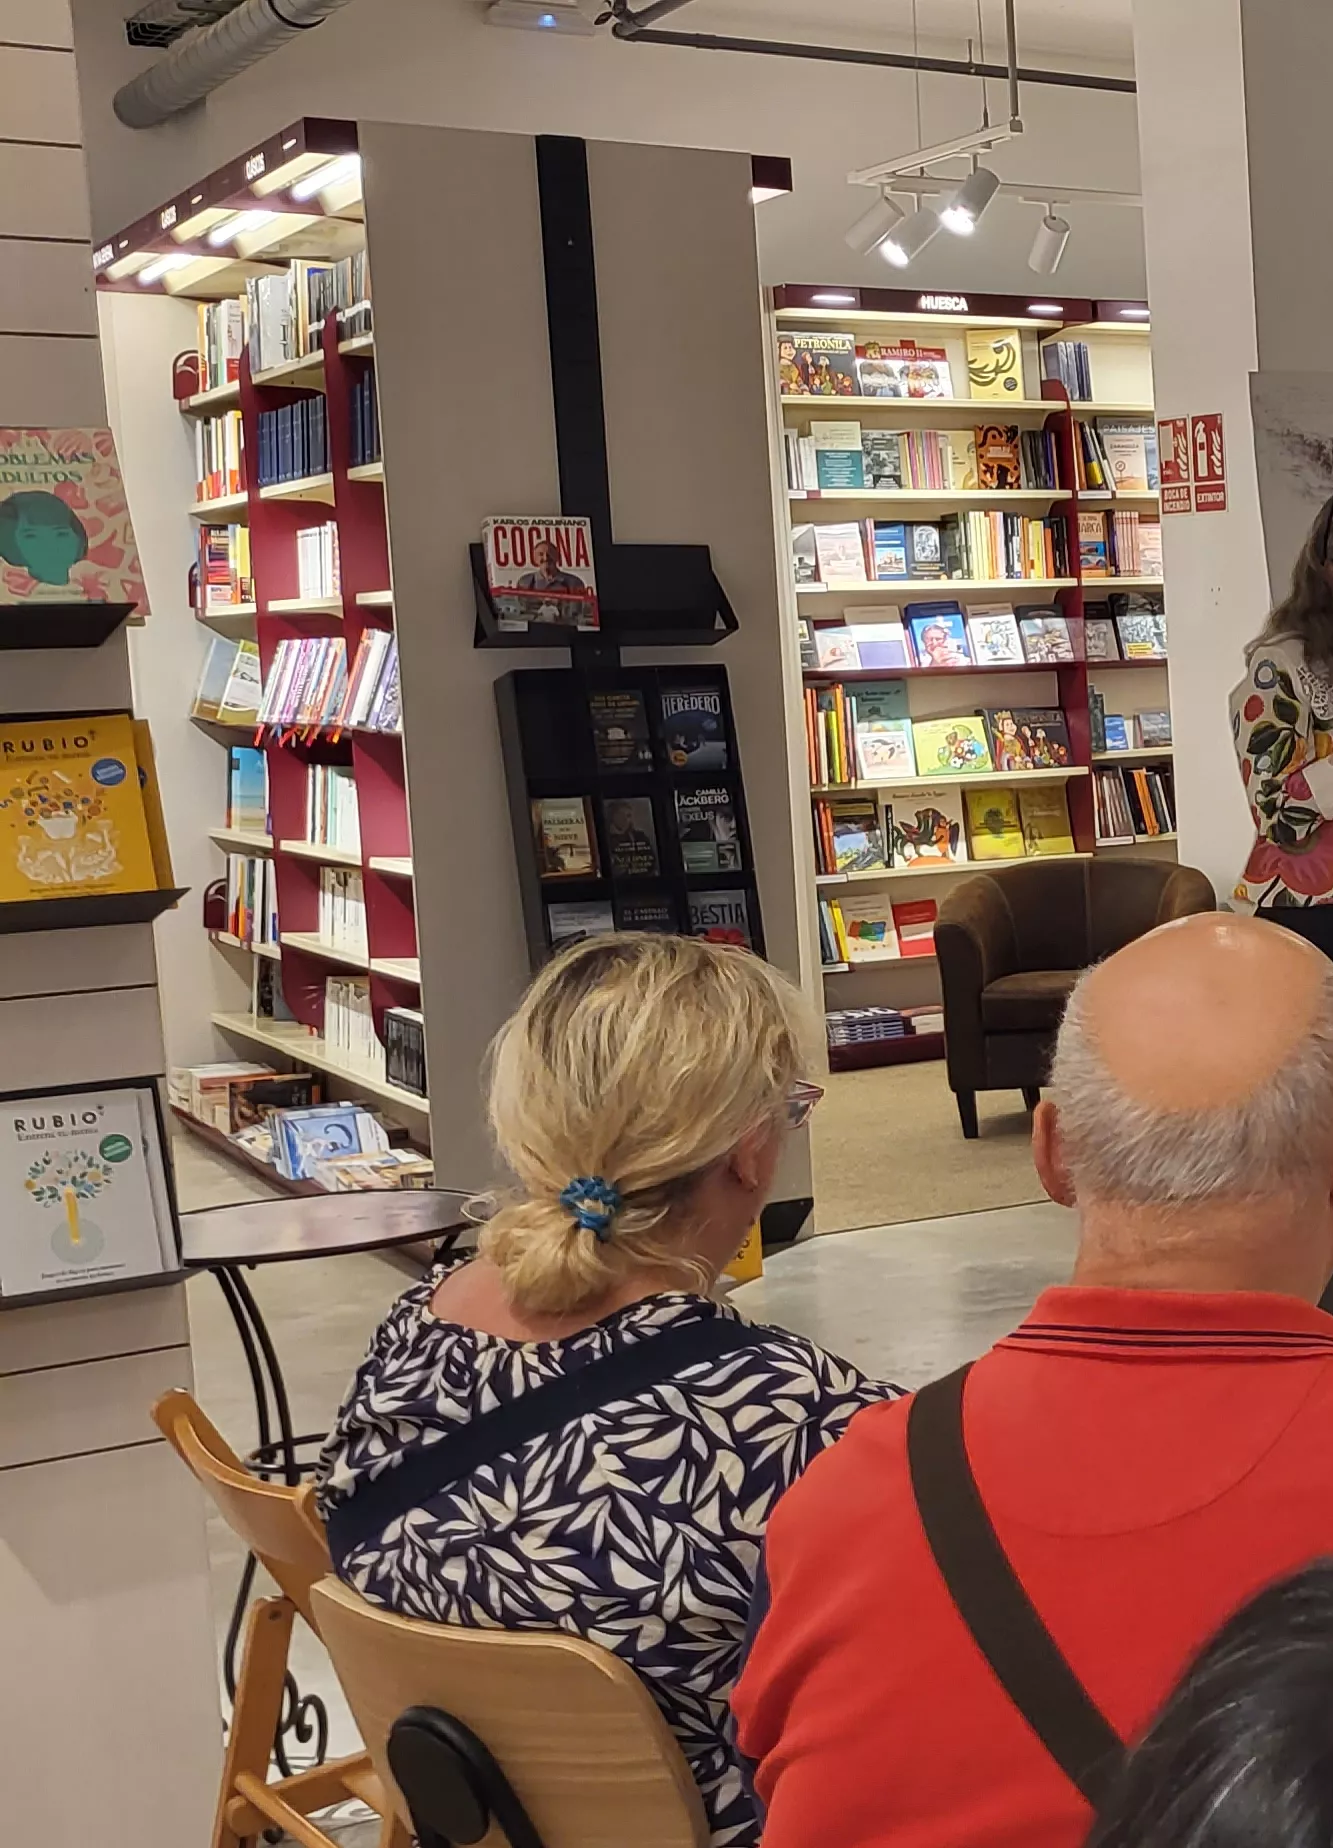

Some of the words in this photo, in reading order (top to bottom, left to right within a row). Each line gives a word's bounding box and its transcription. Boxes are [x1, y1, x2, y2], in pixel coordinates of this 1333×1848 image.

[921, 295, 969, 312] HUESCA
[794, 338, 852, 350] PETRONILA
[1164, 489, 1179, 500] BOCA
[1180, 488, 1188, 499] DE
[531, 519, 587, 527] ARGUIÑANO
[662, 695, 720, 720] HEREDERO
[3, 735, 88, 753] RUBIO
[695, 788, 727, 796] CAMILLA
[691, 903, 744, 925] BESTIA
[14, 1111, 97, 1132] RUBIO
